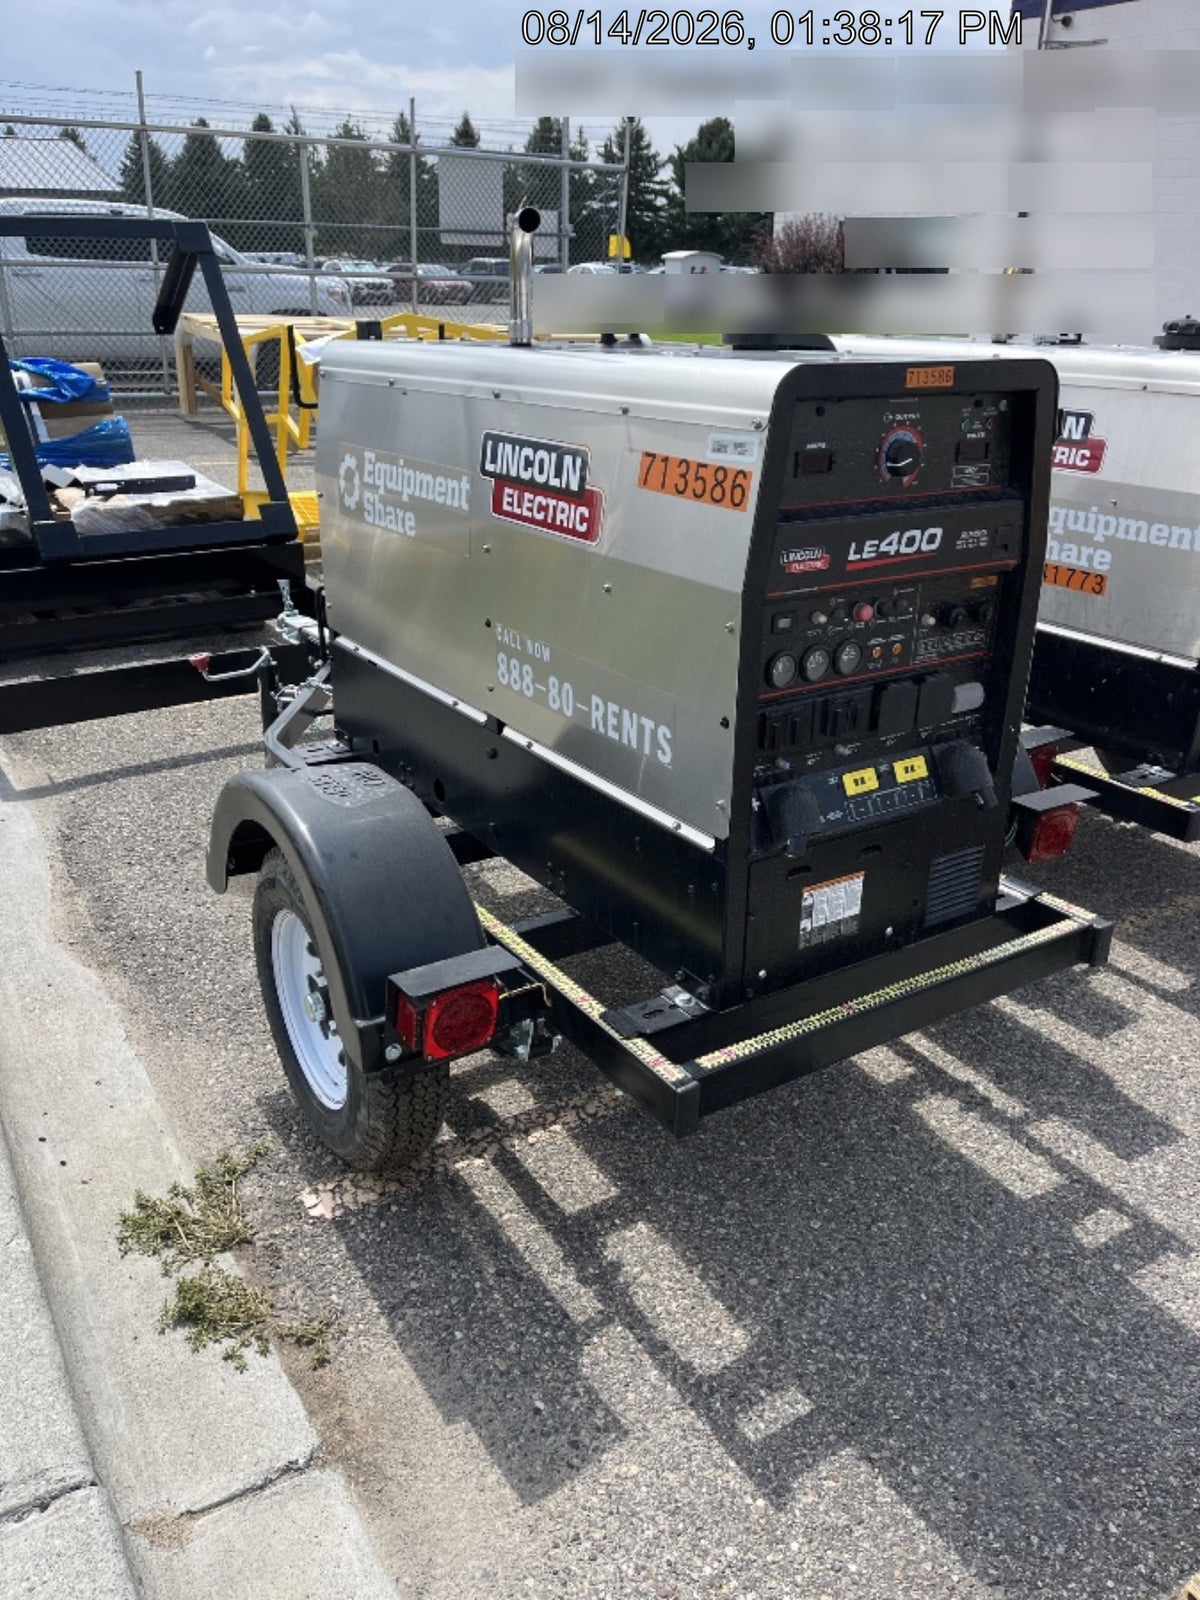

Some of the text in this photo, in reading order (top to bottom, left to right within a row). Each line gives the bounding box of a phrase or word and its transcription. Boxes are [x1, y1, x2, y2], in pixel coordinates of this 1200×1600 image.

[908, 369, 952, 385] 713586
[363, 451, 470, 511] Equipment
[485, 440, 582, 492] LINCOLN
[643, 451, 747, 507] 713586
[363, 490, 416, 538] Share
[503, 486, 589, 532] ELECTRIC
[1048, 506, 1200, 552] quipmen
[847, 527, 943, 561] LE400
[1046, 533, 1112, 571] hare
[495, 624, 551, 662] CALL NOW
[497, 652, 672, 764] 888-80-RENTS
